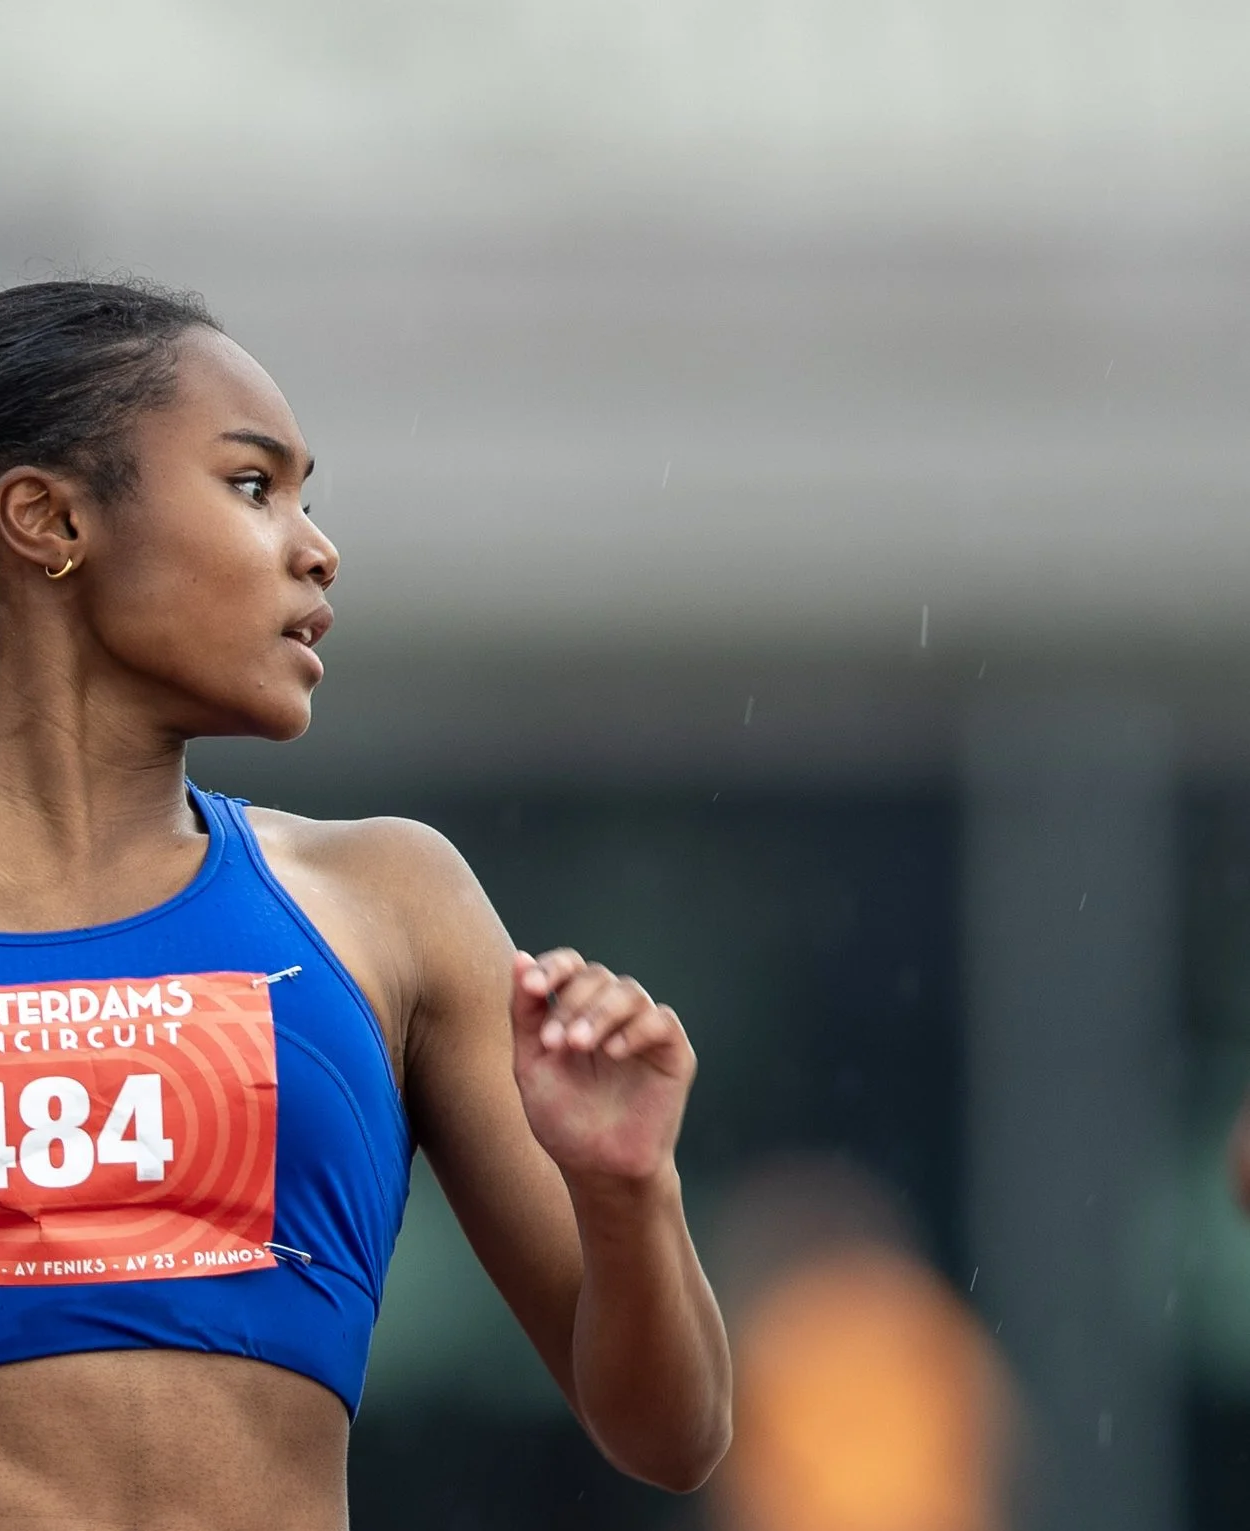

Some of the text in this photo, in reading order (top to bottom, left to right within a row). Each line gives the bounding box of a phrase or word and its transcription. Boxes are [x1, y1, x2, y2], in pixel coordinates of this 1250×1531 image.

[14, 1262, 37, 1276] AV
[43, 1258, 106, 1276] FENIKS
[125, 1255, 147, 1272] AV
[152, 1253, 175, 1270] 23
[193, 1247, 266, 1267] PHANOS
